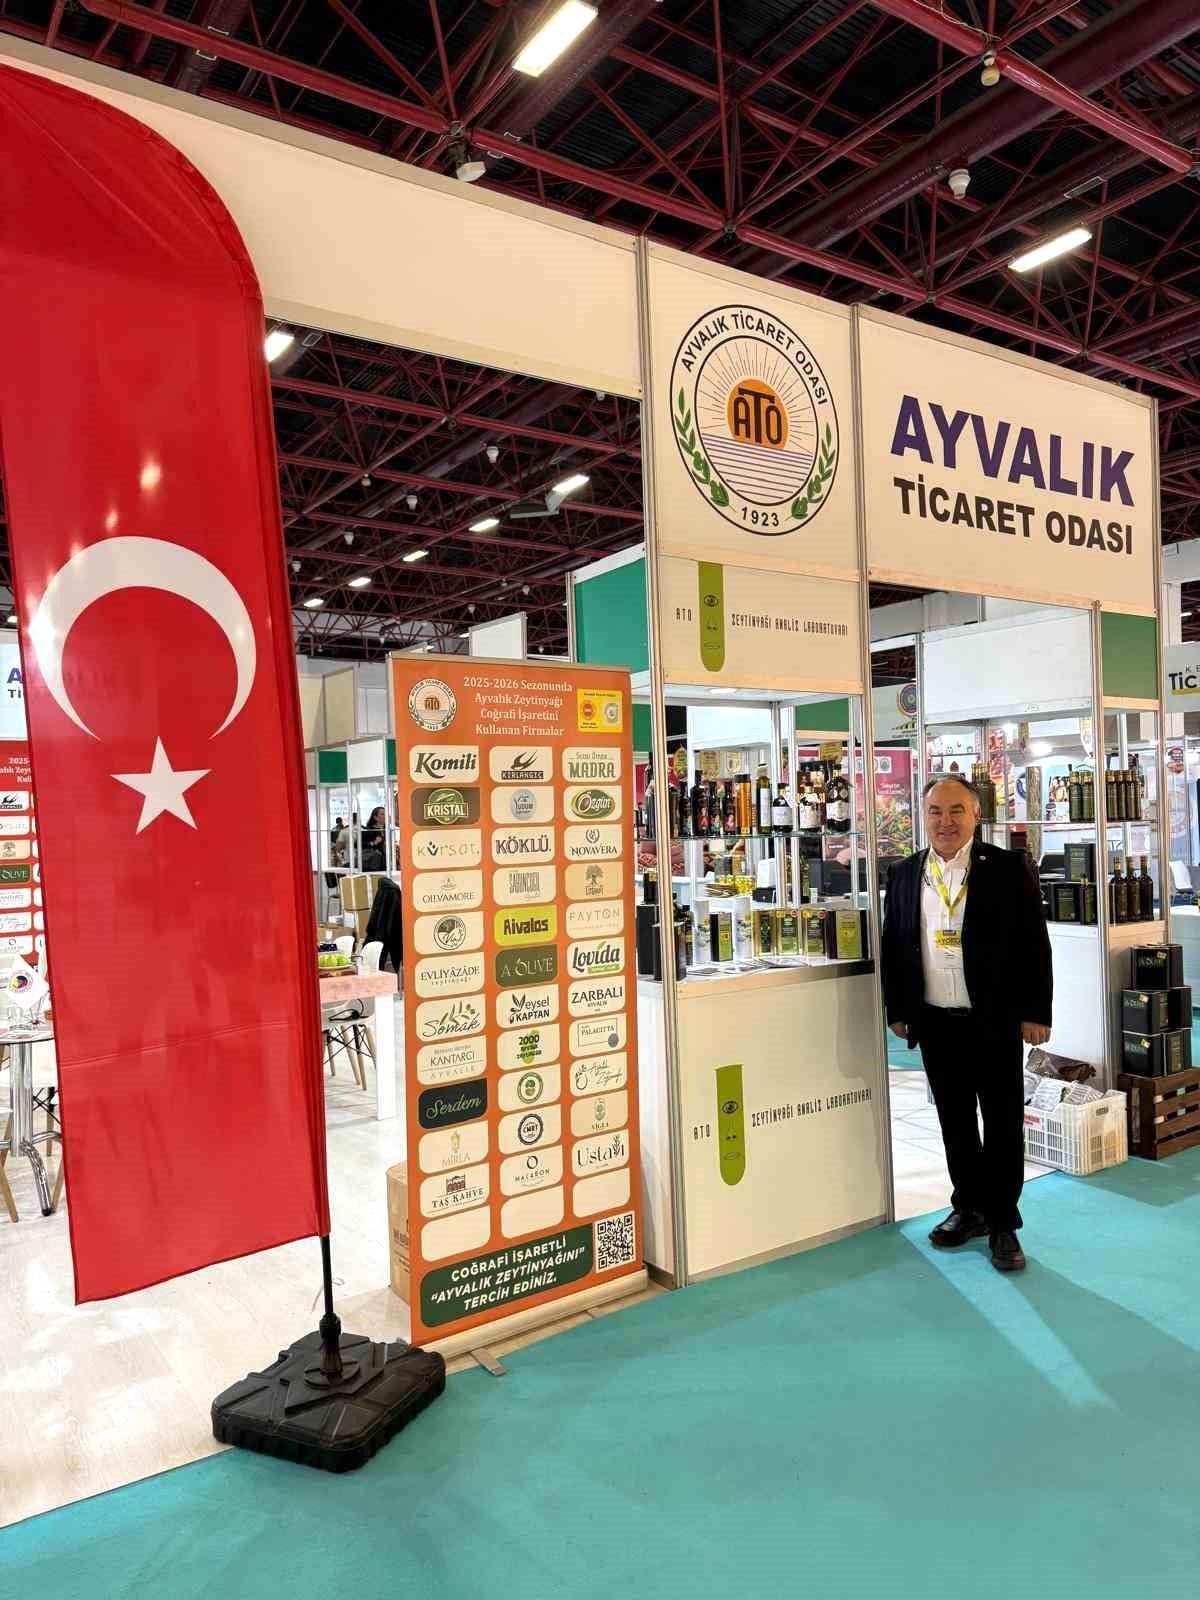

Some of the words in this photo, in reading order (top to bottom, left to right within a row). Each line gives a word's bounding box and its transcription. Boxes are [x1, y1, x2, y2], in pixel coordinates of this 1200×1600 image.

[680, 316, 730, 373] AYVALIK
[731, 309, 796, 352] TİCARET
[795, 350, 829, 406] ODASI
[733, 388, 783, 445] ATO
[890, 394, 1135, 508] AYVALIK
[741, 506, 780, 528] 1923
[893, 473, 1036, 538] TİCARET
[1045, 511, 1132, 555] ODASI
[675, 607, 692, 622] ATO
[775, 616, 799, 632] ANALİZ
[463, 676, 519, 690] 2025-2026
[520, 679, 573, 692] Sezonunda
[475, 690, 512, 705] Ayvalık
[513, 692, 563, 707] Zeytinyağı
[480, 707, 515, 722] Coğrafi
[517, 708, 559, 722] İşaretini
[476, 724, 520, 736] Kullanan
[522, 726, 565, 737] Firmalar
[414, 752, 477, 779] Komili
[568, 761, 616, 779] MADRA
[571, 846, 617, 857] NOVAVERA
[573, 943, 620, 972] Lovida
[571, 986, 623, 1004] ZARBALI
[515, 1009, 550, 1023] KAPTAN
[518, 1034, 540, 1046] 2000
[425, 1094, 481, 1120] Serdem
[693, 1124, 711, 1140] ATO
[751, 1104, 793, 1128] ZEYTİNYAĞI
[797, 1098, 822, 1116] ANALİZ
[826, 1088, 872, 1109] LABORATUVARI
[452, 1188, 485, 1204] KAHVE
[451, 1255, 509, 1282] COĞRAFİ
[512, 1235, 567, 1263] İŞARETLİ
[463, 1286, 510, 1312] TERCİH
[512, 1270, 558, 1295] EDİNİZ.
